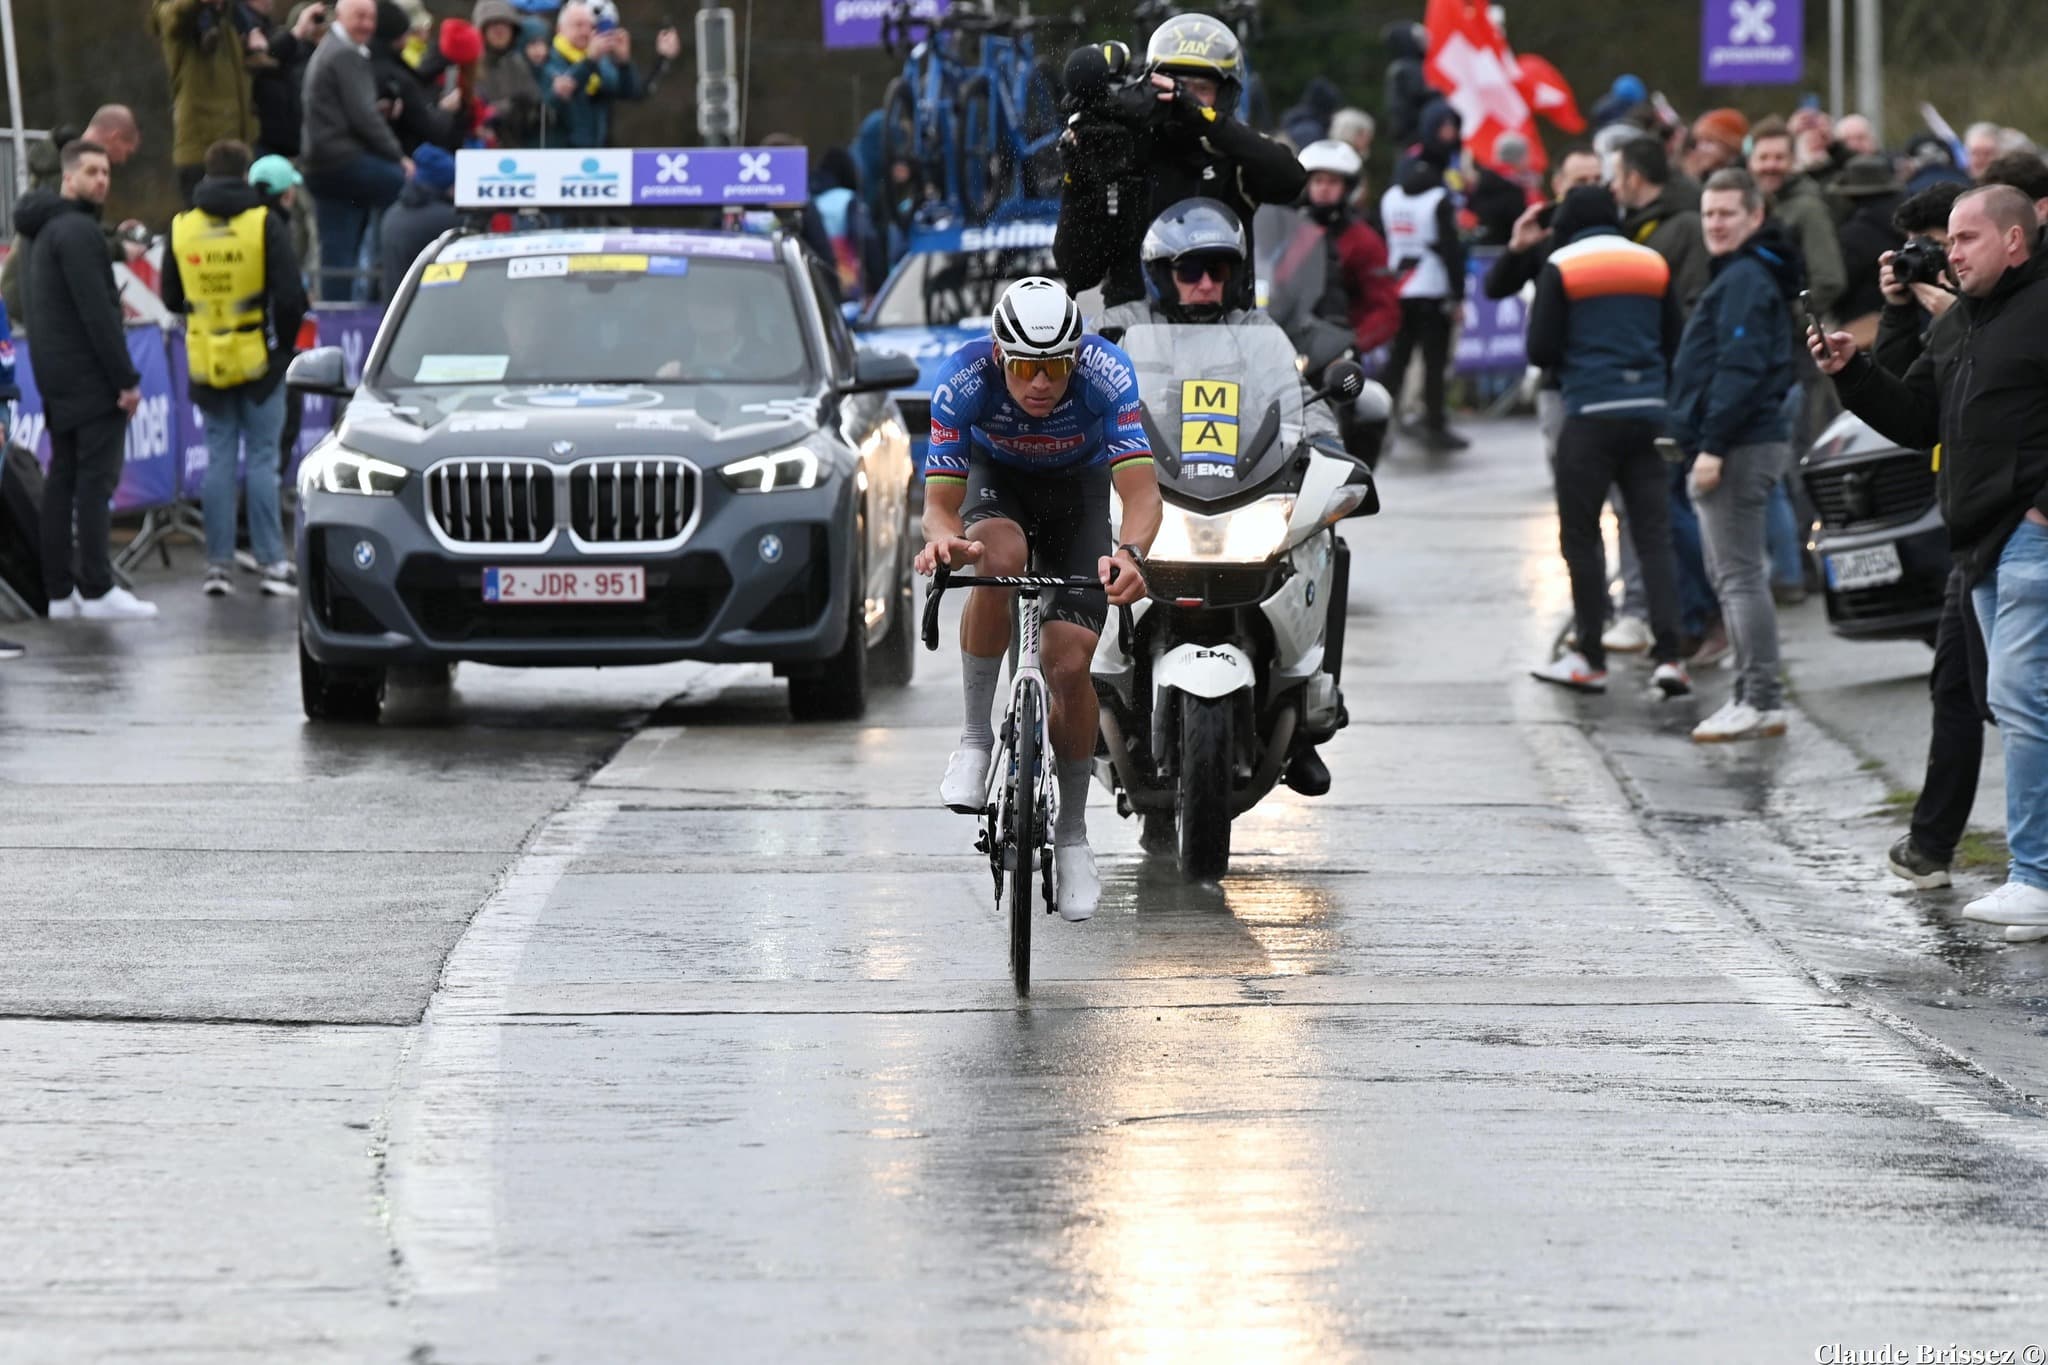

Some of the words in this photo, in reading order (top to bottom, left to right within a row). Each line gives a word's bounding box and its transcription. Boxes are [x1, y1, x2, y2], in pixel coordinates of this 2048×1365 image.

[1176, 40, 1211, 56] JAN
[477, 184, 537, 198] KBC
[560, 184, 619, 198] KBC
[641, 184, 702, 198] proximus
[723, 183, 786, 197] proximus
[950, 357, 988, 389] PREMIER
[1079, 344, 1133, 394] Alpecin
[959, 376, 984, 399] TECH
[1194, 385, 1227, 408] M
[1195, 420, 1223, 447] A
[1196, 463, 1235, 478] EMG
[1195, 650, 1237, 667] EMG
